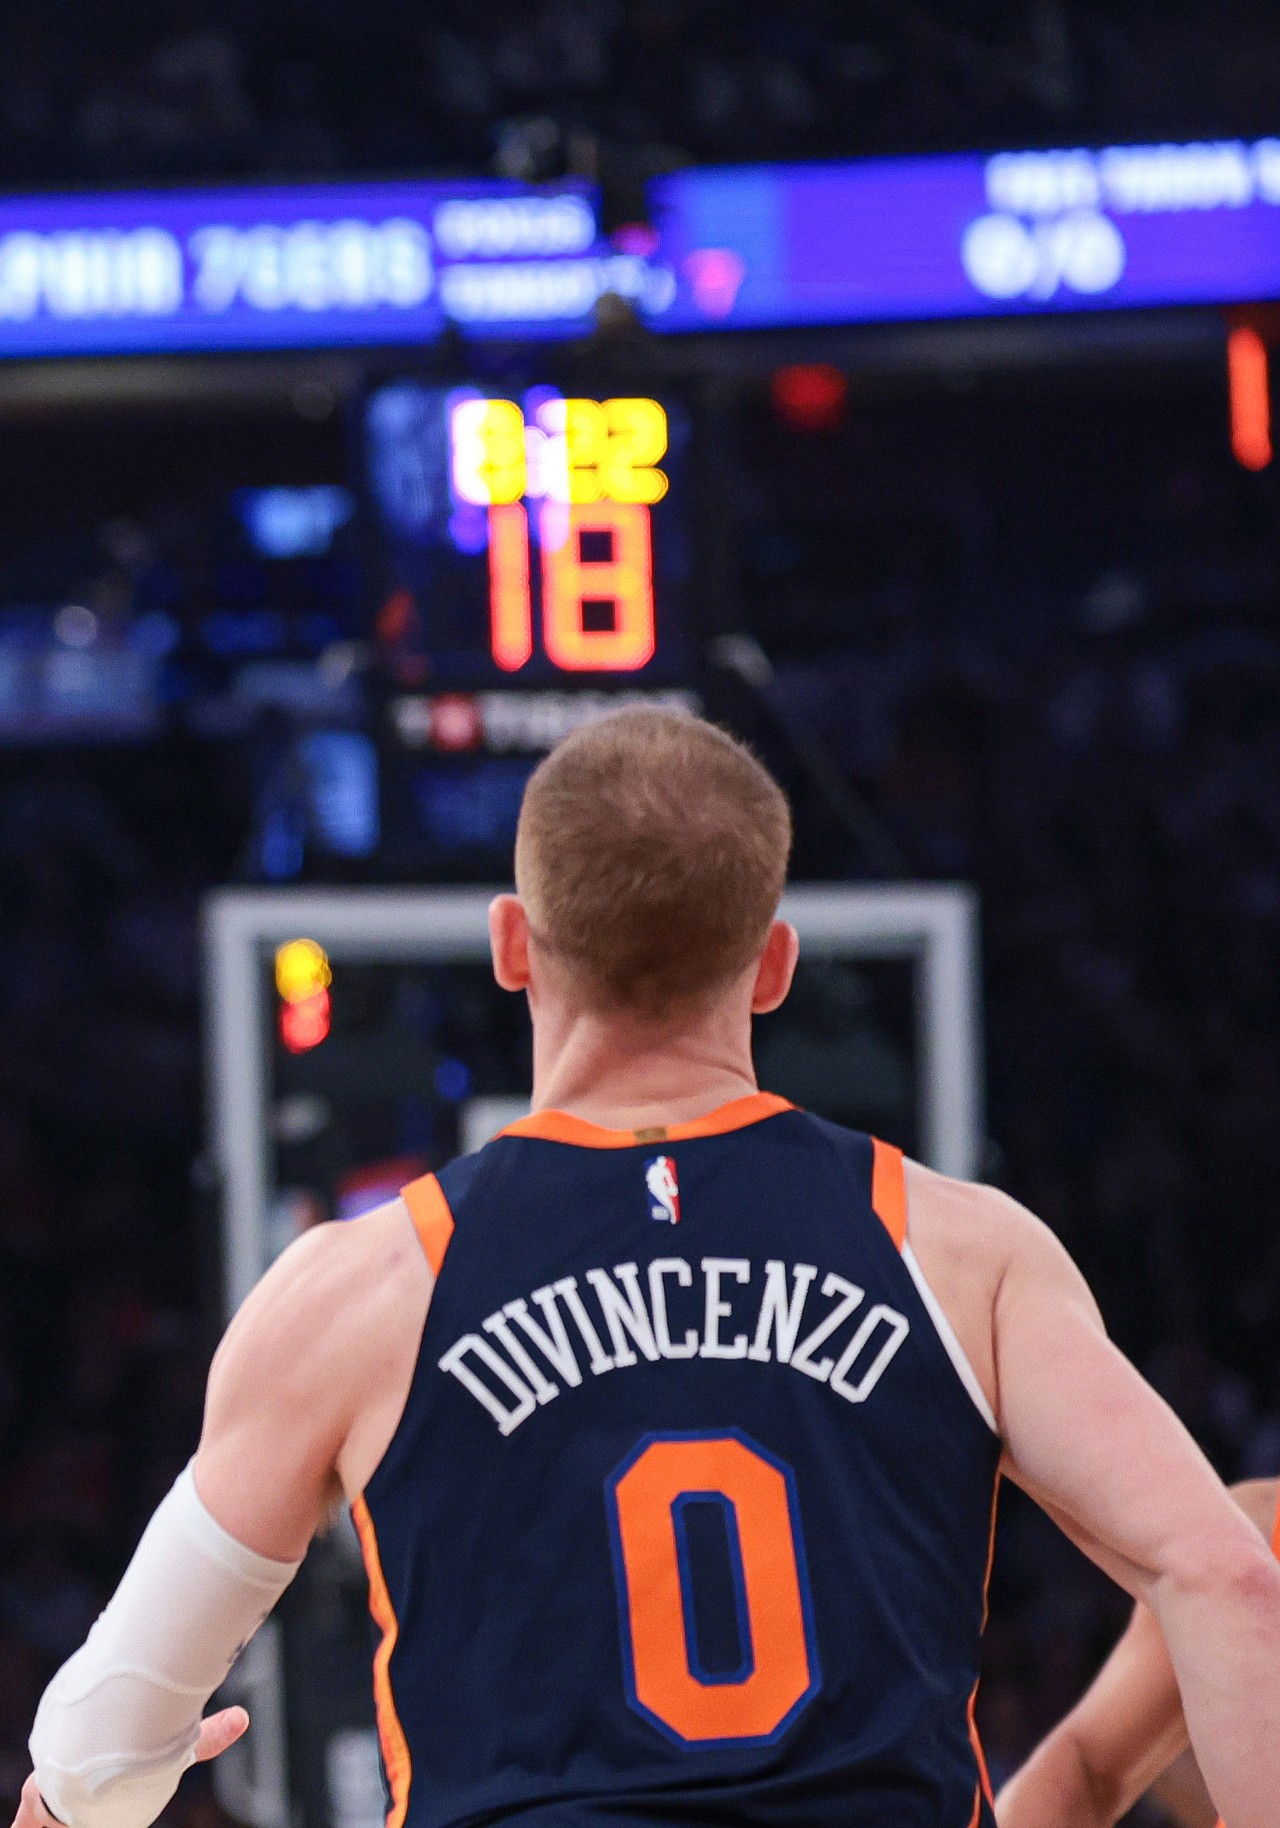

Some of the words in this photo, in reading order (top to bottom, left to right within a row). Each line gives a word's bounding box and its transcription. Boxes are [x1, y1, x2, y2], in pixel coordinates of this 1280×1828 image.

[488, 500, 658, 673] 18
[438, 1257, 910, 1436] DIVINCENZO
[604, 1428, 822, 1753] 0
